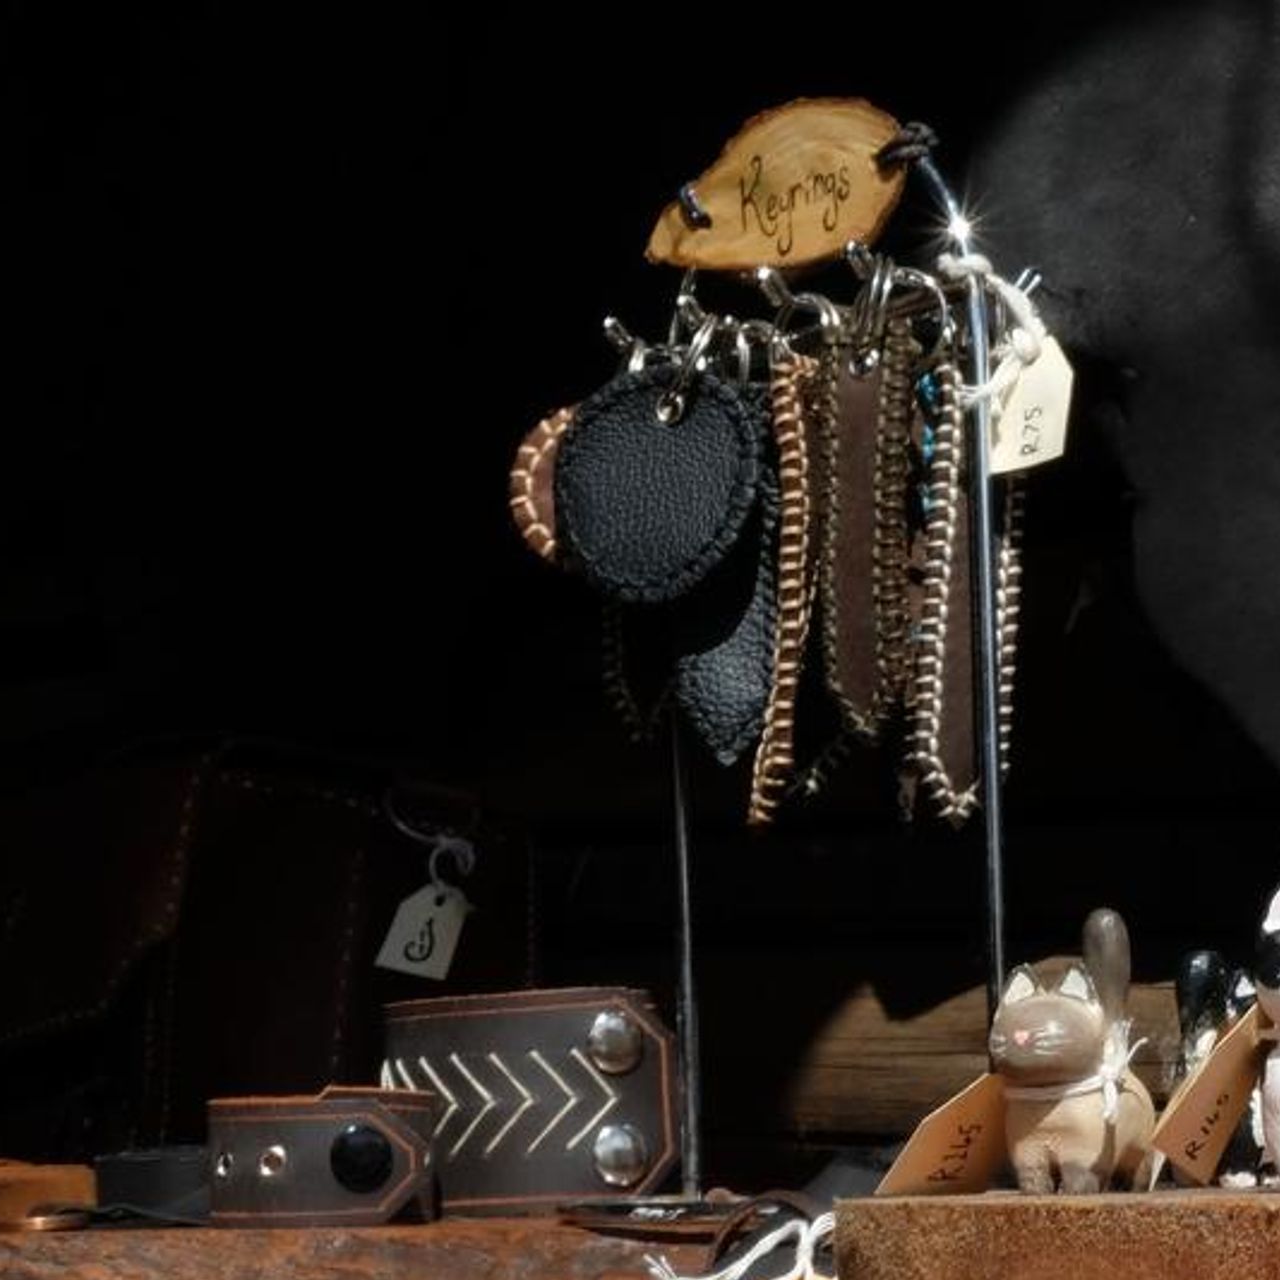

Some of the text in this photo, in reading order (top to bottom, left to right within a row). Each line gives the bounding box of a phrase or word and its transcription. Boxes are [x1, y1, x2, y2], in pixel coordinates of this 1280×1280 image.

[738, 154, 851, 257] Keyrings
[1020, 406, 1043, 456] R75
[927, 1123, 984, 1182] R165
[1186, 1093, 1230, 1160] R165
